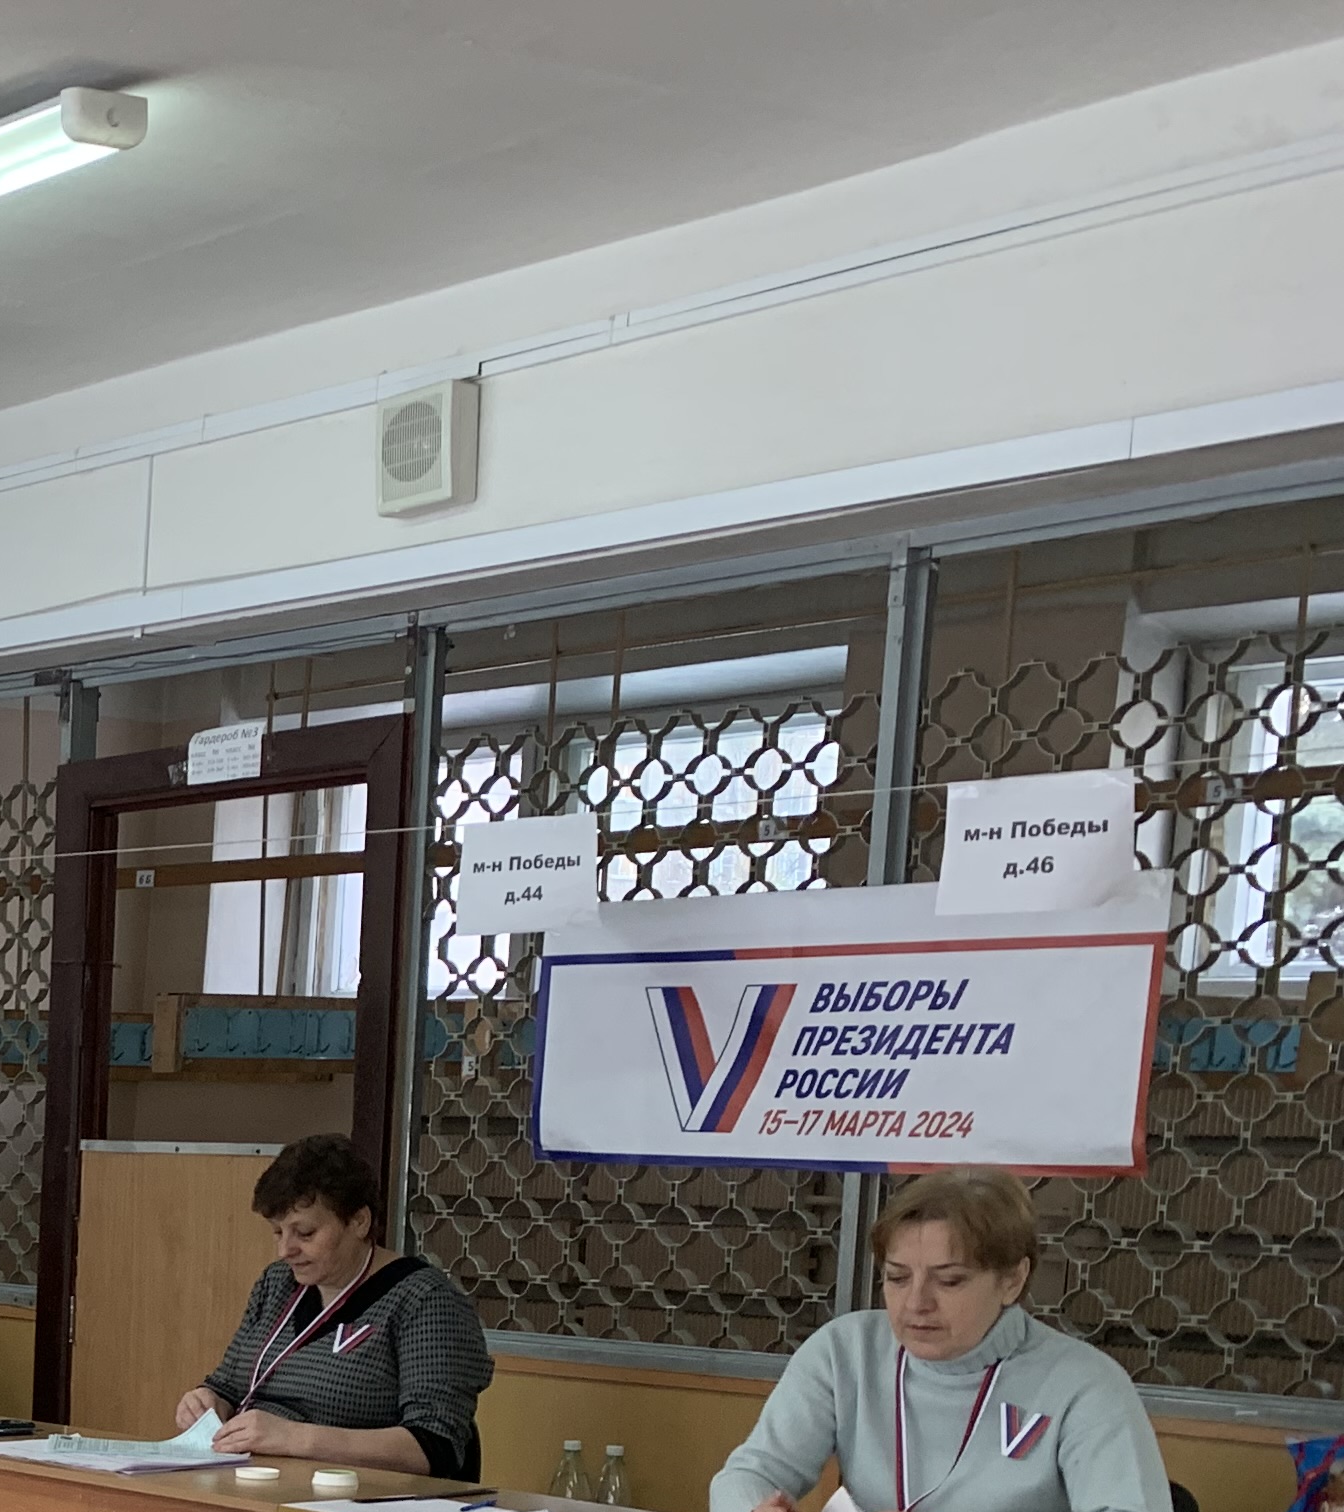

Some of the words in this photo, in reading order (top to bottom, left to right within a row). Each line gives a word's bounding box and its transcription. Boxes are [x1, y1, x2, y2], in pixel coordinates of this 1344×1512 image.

[194, 729, 239, 746] Гардероб
[964, 827, 1002, 842] м-н
[1011, 818, 1109, 838] Победы
[473, 861, 502, 873] м-н
[509, 854, 581, 871] Победы
[1003, 856, 1054, 879] д.46
[504, 885, 543, 905] д.44
[809, 979, 970, 1013] ВЫБОРЫ
[792, 1023, 1015, 1060] ПРЕЗИДЕНТА
[775, 1068, 911, 1099] РОССИИ
[823, 1111, 908, 1137] МАРТА
[909, 1111, 975, 1138] 2024
